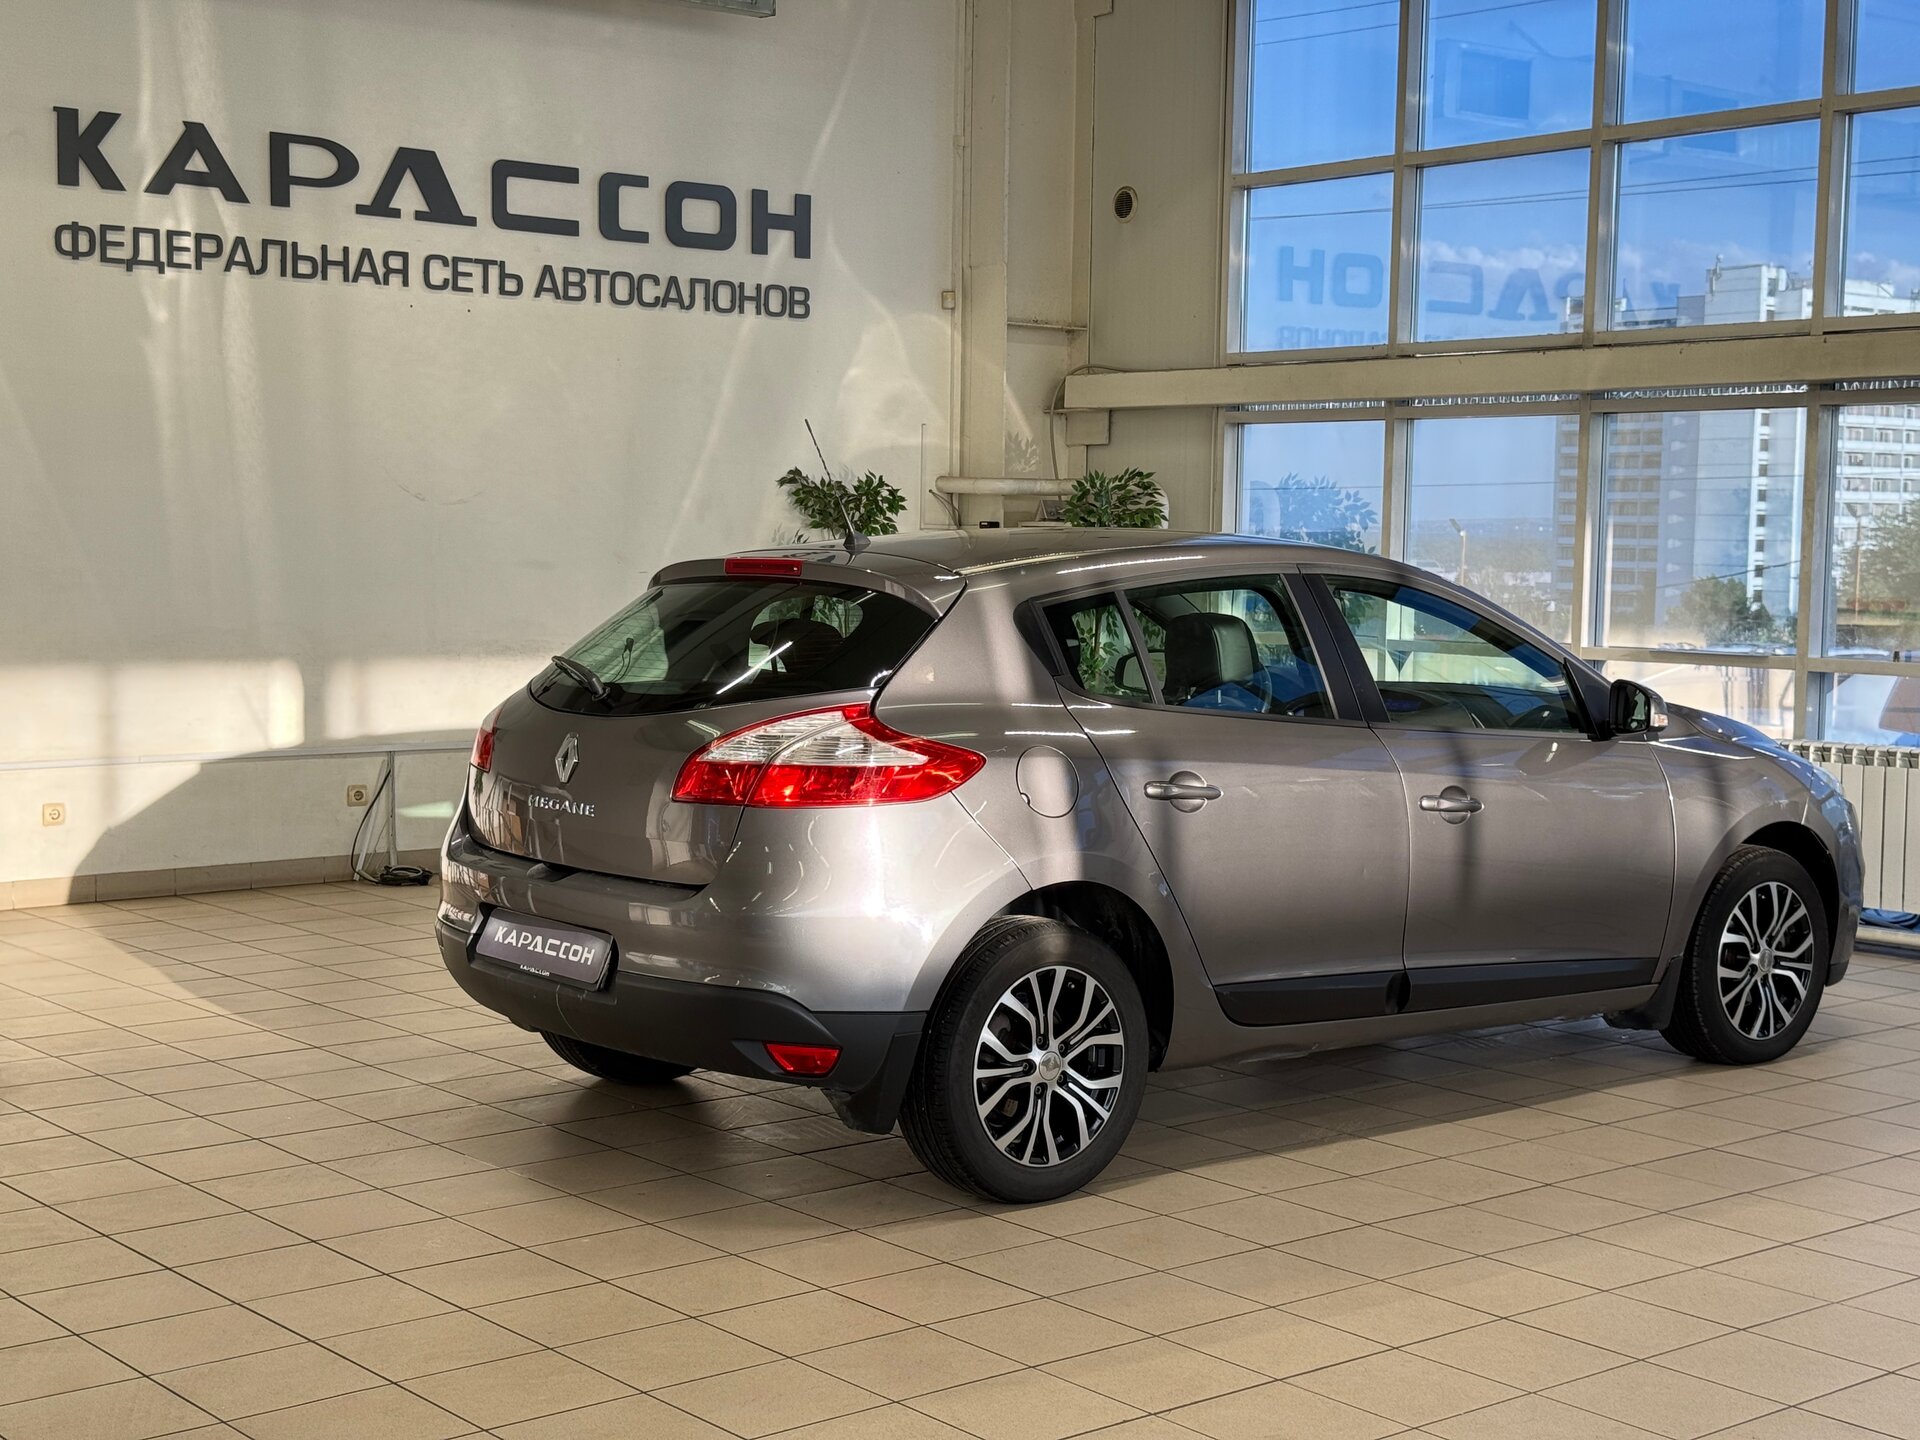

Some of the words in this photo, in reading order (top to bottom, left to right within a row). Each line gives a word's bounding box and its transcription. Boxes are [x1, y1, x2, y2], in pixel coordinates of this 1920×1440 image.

[54, 221, 409, 287] ФЕДЕРАЛЬНАЯ
[422, 254, 523, 296] СЕТЬ
[534, 265, 811, 319] АВТОСАЛОНОВ
[528, 795, 595, 817] MEGANE
